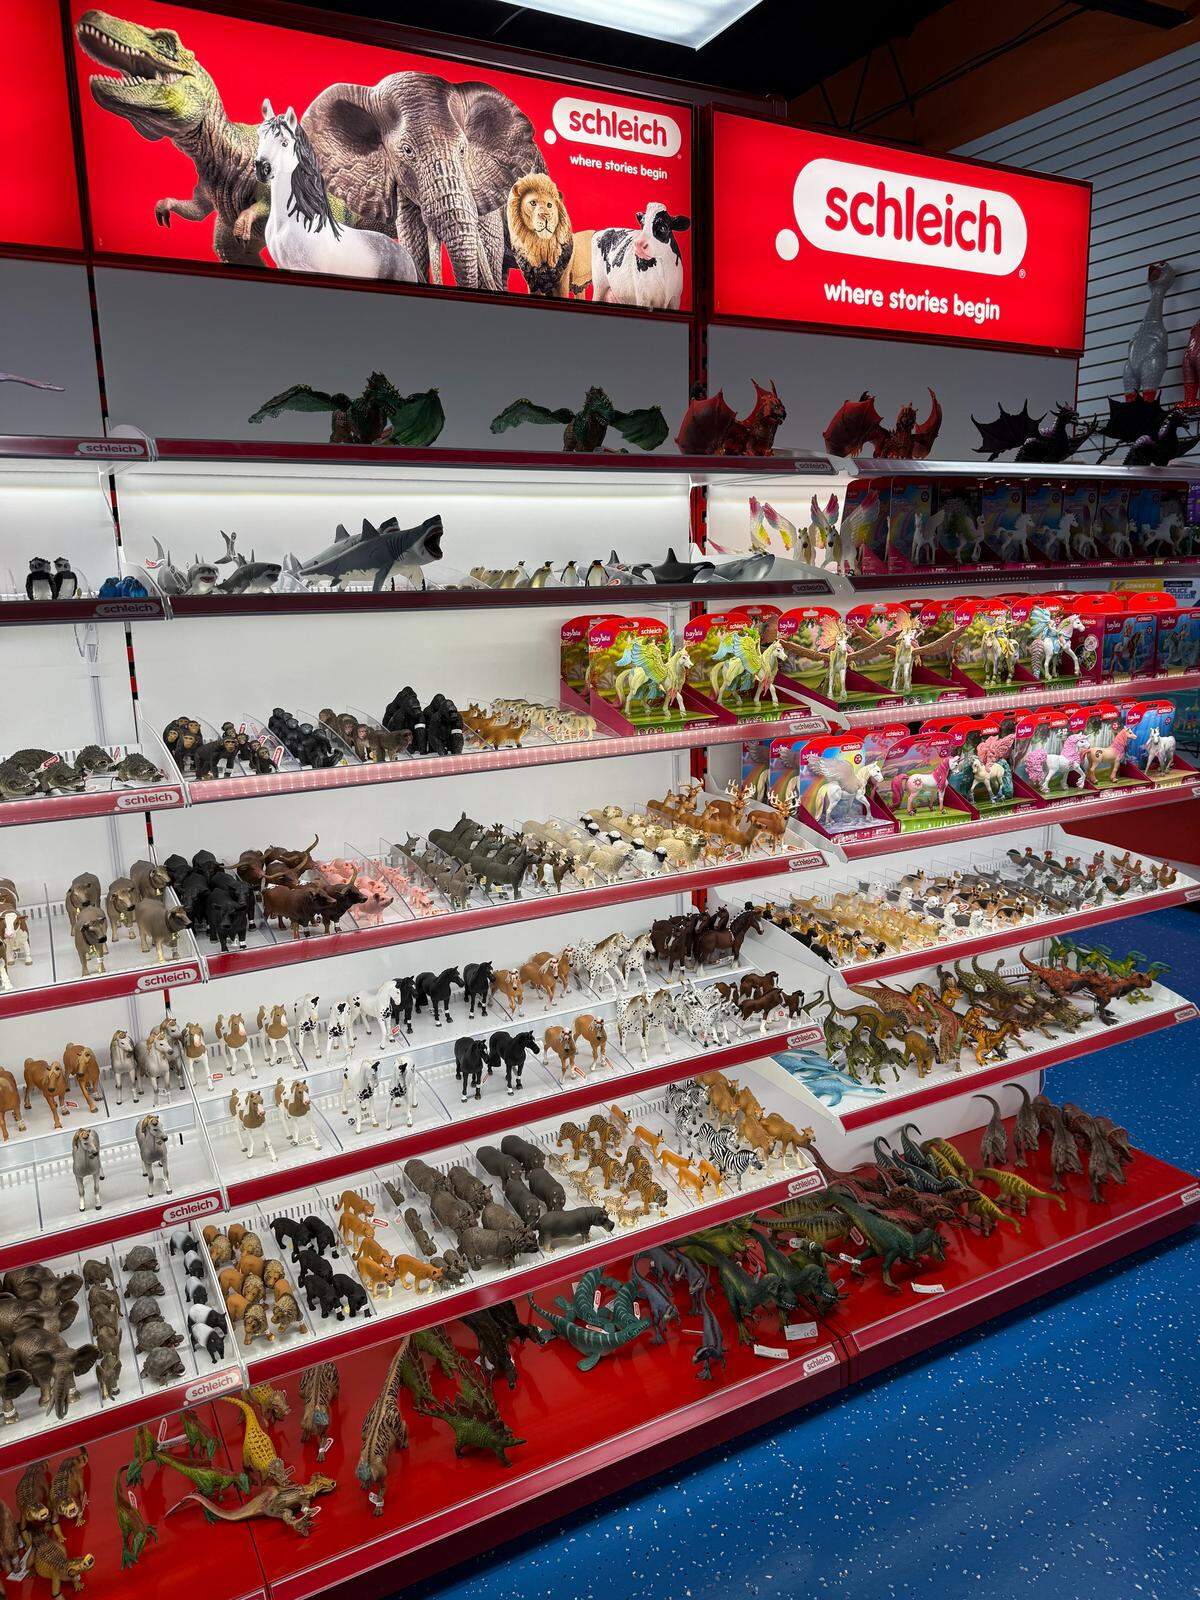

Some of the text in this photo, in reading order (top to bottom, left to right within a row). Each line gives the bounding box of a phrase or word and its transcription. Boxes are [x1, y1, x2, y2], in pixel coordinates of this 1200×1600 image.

[569, 108, 667, 147] schleich
[570, 155, 668, 181] where stories begin
[825, 181, 1002, 256] schleich
[824, 279, 1000, 325] where stories begin
[86, 444, 137, 453] schleich
[104, 604, 152, 613] schleich
[591, 634, 611, 645] bayala
[125, 793, 172, 806] schleich
[793, 857, 820, 867] schleich
[145, 971, 190, 987] schleich
[791, 1032, 817, 1044] schleich
[792, 1176, 817, 1191] schleich
[170, 1200, 213, 1219] schleich
[806, 1354, 833, 1370] schleich
[192, 1376, 233, 1397] schleich
